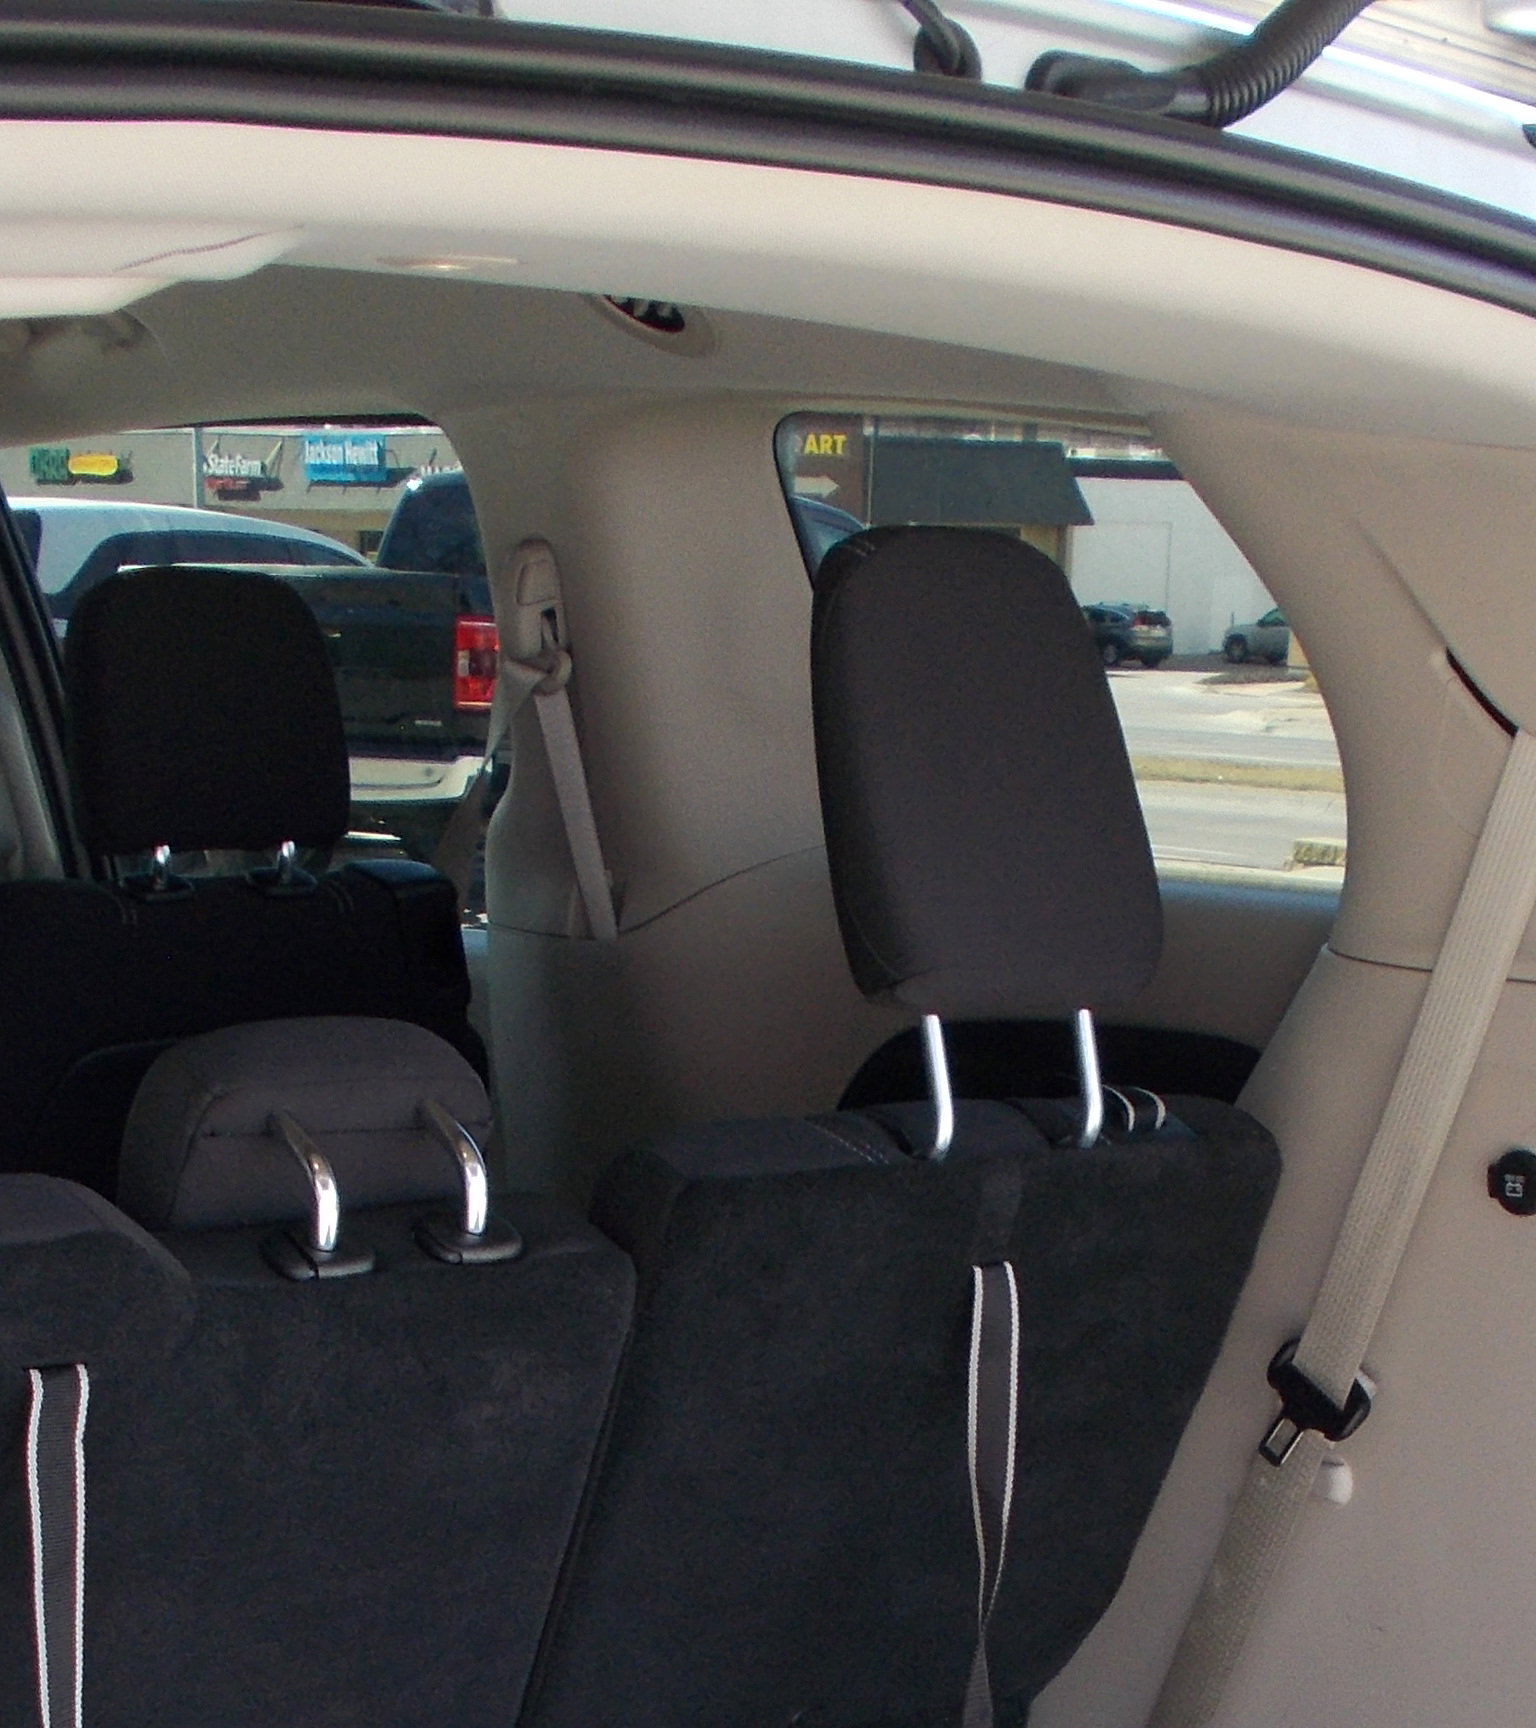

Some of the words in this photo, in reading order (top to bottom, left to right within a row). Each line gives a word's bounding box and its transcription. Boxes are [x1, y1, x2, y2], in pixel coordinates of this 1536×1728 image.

[305, 440, 343, 464] Jackson
[345, 440, 379, 465] Hewitt
[804, 433, 847, 455] ART
